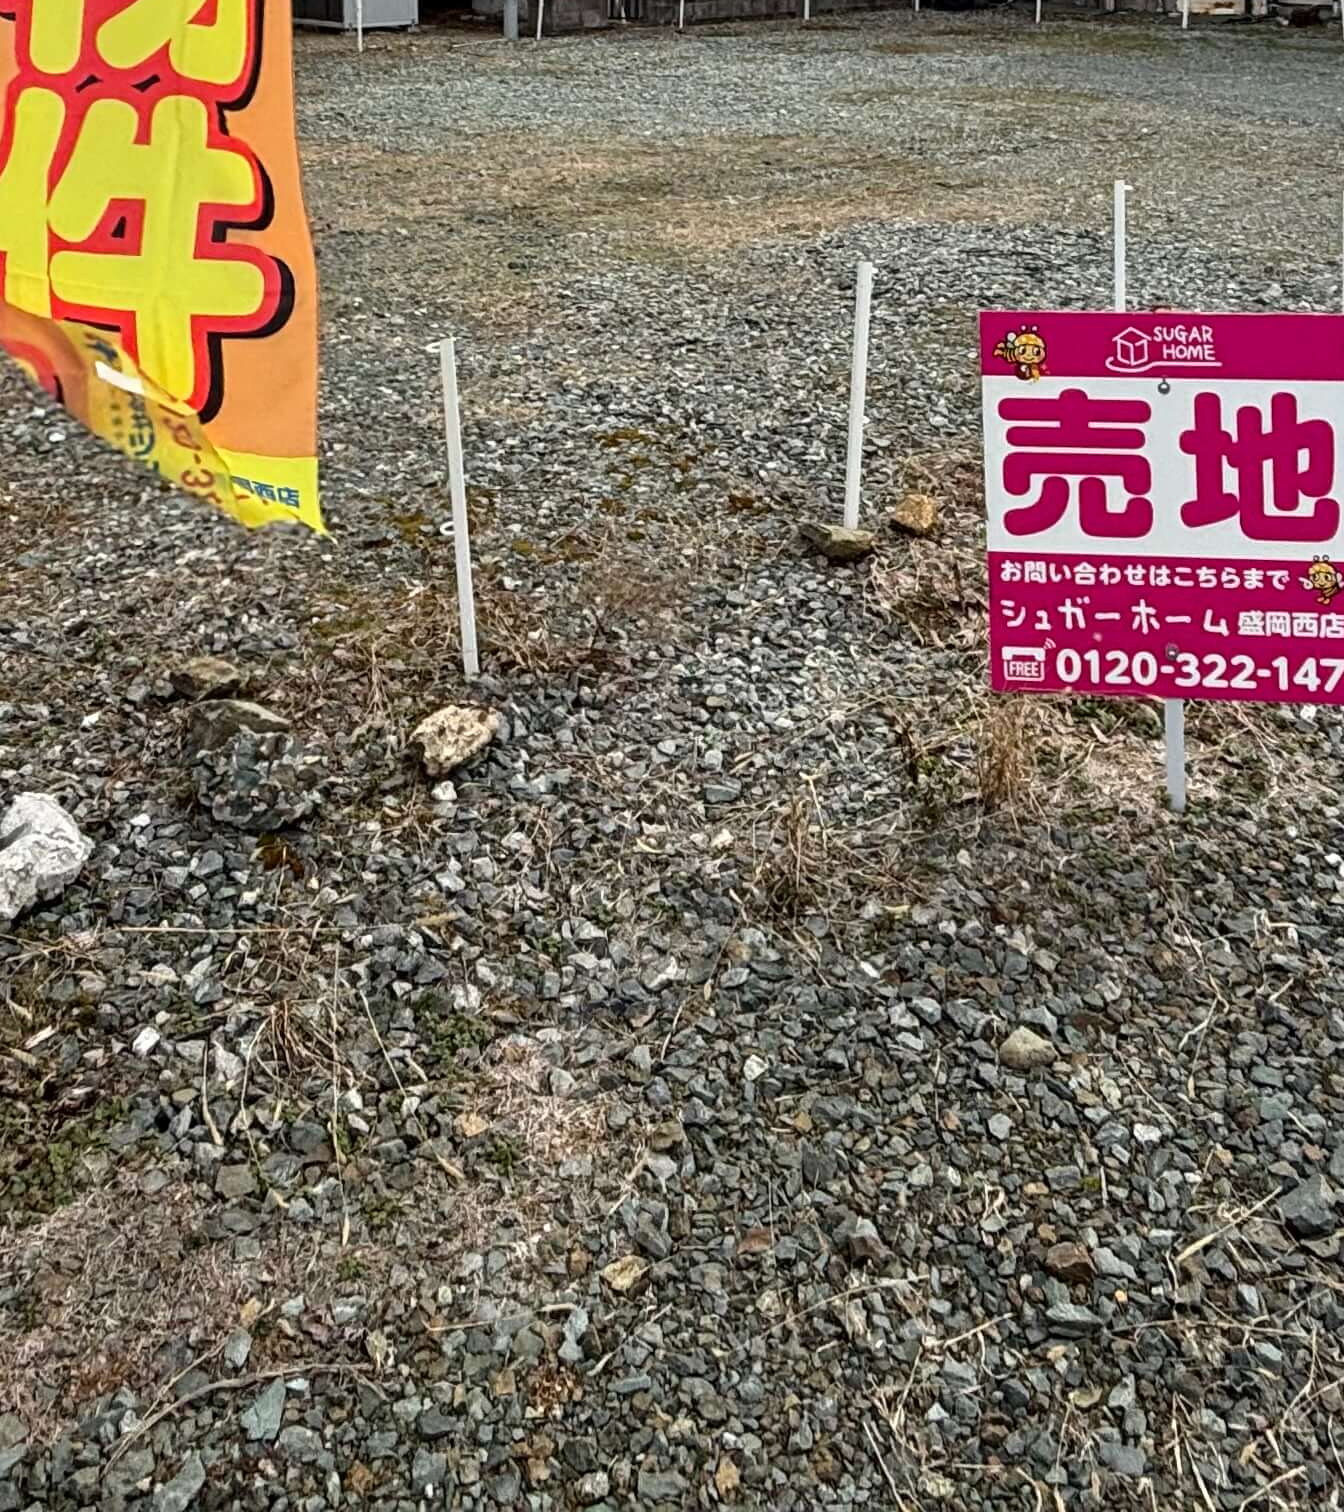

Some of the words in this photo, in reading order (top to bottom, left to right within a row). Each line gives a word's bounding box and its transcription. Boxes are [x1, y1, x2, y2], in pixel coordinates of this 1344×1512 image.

[1152, 324, 1215, 343] SUGAR
[1161, 343, 1217, 362] HOME
[996, 387, 1342, 543] 売地
[999, 558, 1291, 592] お問い合わせはこちらまで
[1000, 597, 1231, 636] シュガーホーム
[1008, 660, 1040, 680] FREE
